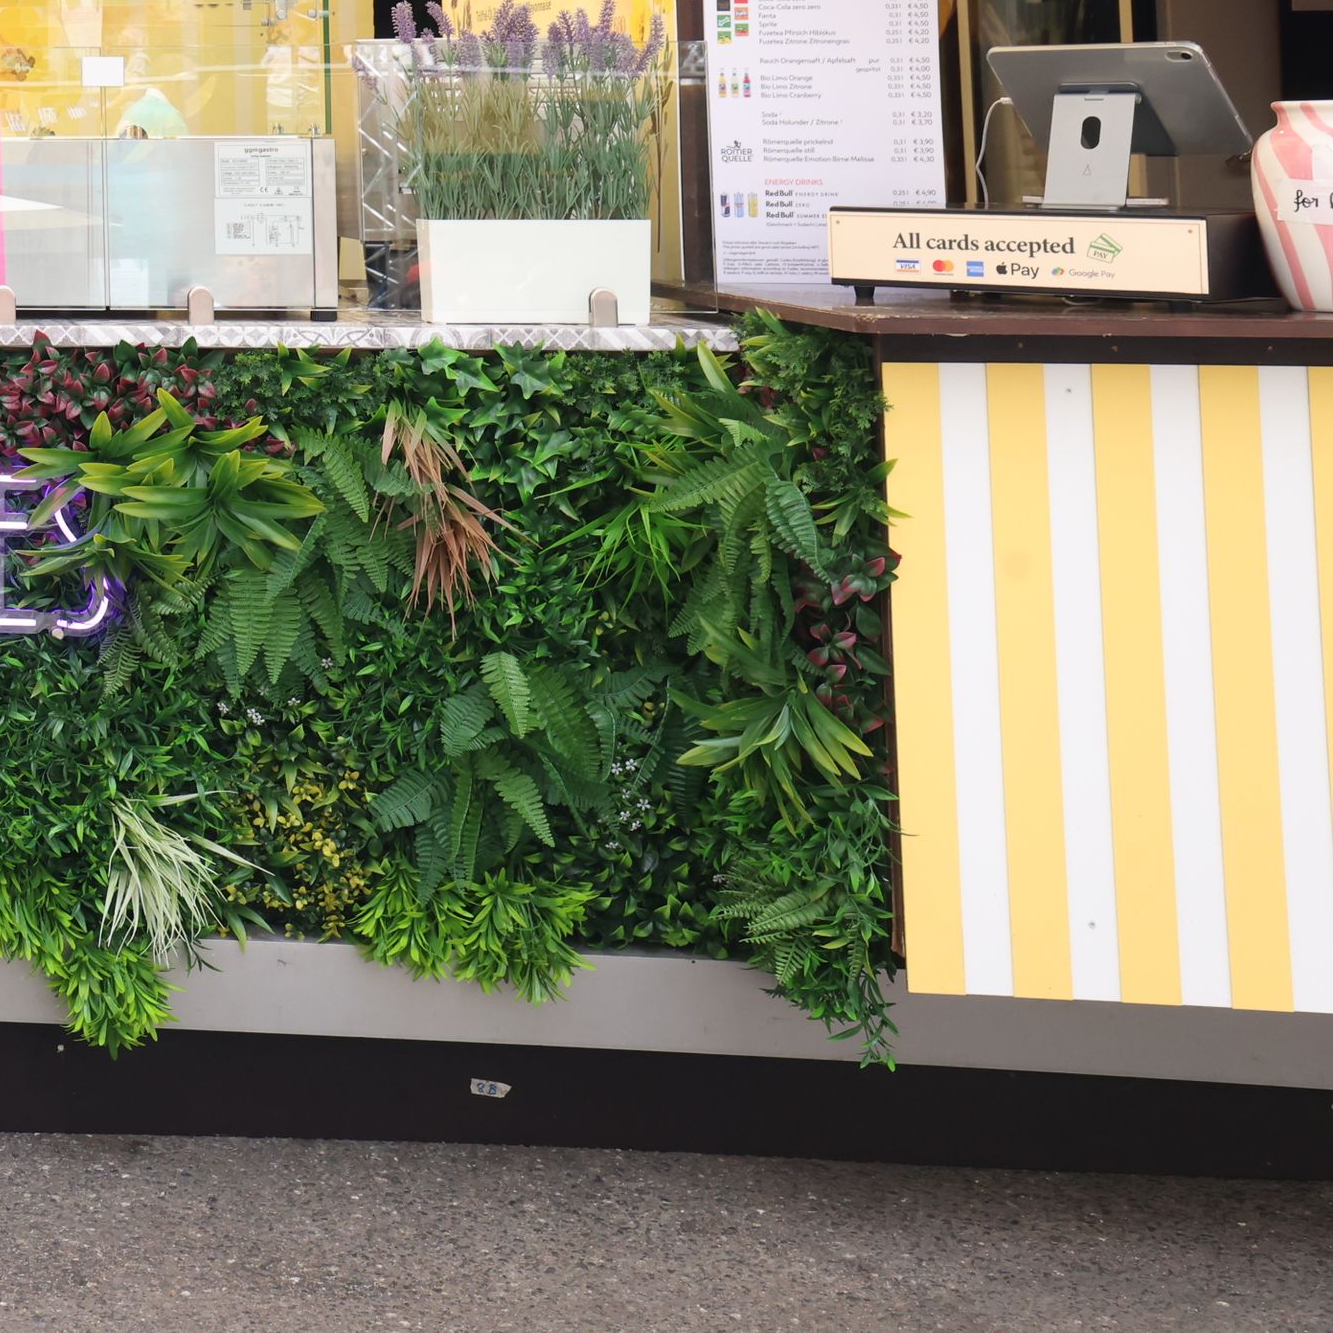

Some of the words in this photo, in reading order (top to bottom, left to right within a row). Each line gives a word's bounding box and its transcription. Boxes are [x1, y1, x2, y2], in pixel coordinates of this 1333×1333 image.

[1294, 190, 1319, 212] for
[893, 233, 921, 250] All
[926, 235, 979, 252] cards
[984, 237, 1075, 258] accepted
[1010, 262, 1040, 279] Pay
[1068, 268, 1099, 279] Google
